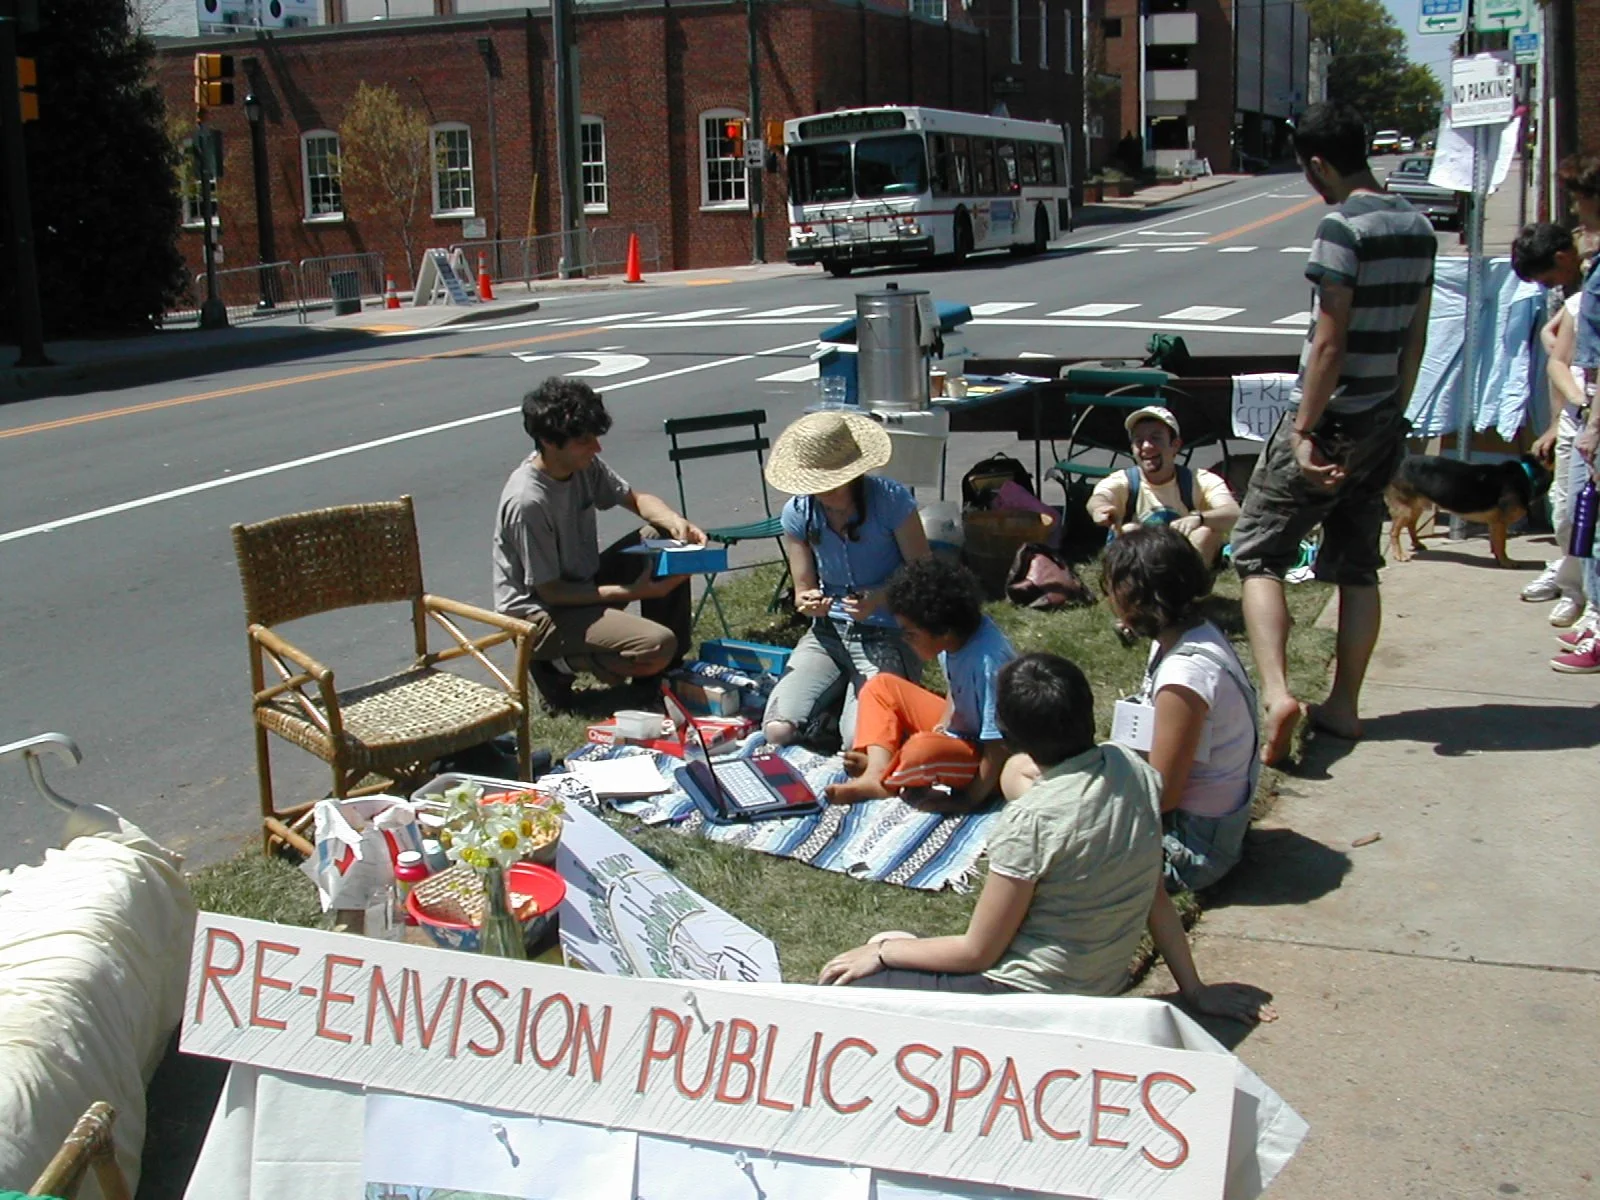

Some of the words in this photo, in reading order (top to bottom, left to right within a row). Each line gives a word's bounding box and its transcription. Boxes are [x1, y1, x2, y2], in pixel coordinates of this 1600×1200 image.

[1453, 84, 1465, 103] NO
[1467, 78, 1513, 103] PARKING
[195, 927, 611, 1083] RE-ENVISION
[636, 1006, 877, 1114] PUBLIC
[895, 1042, 1196, 1169] SPACES
